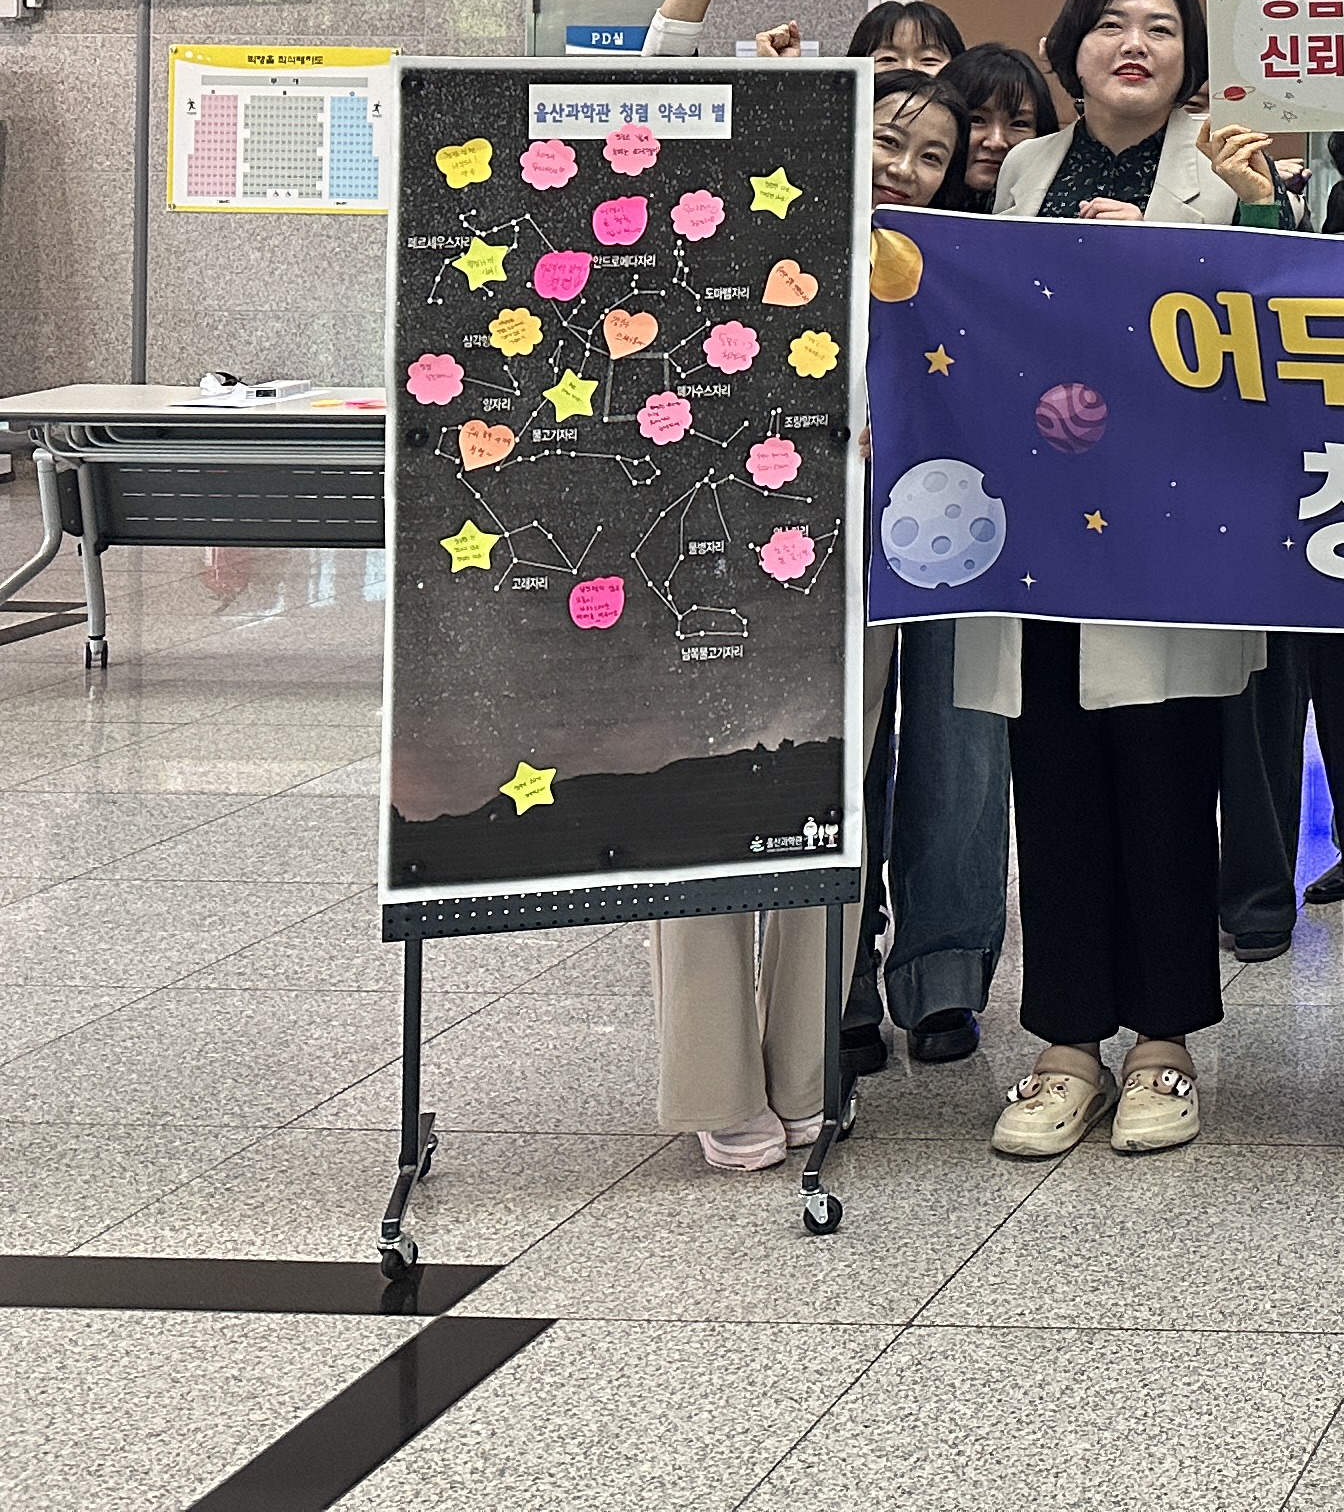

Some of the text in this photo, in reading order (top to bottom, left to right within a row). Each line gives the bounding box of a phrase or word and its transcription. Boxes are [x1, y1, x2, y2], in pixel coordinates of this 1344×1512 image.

[591, 32, 624, 46] PD실
[533, 102, 726, 124] 울산과학관 청렴 약속의 별
